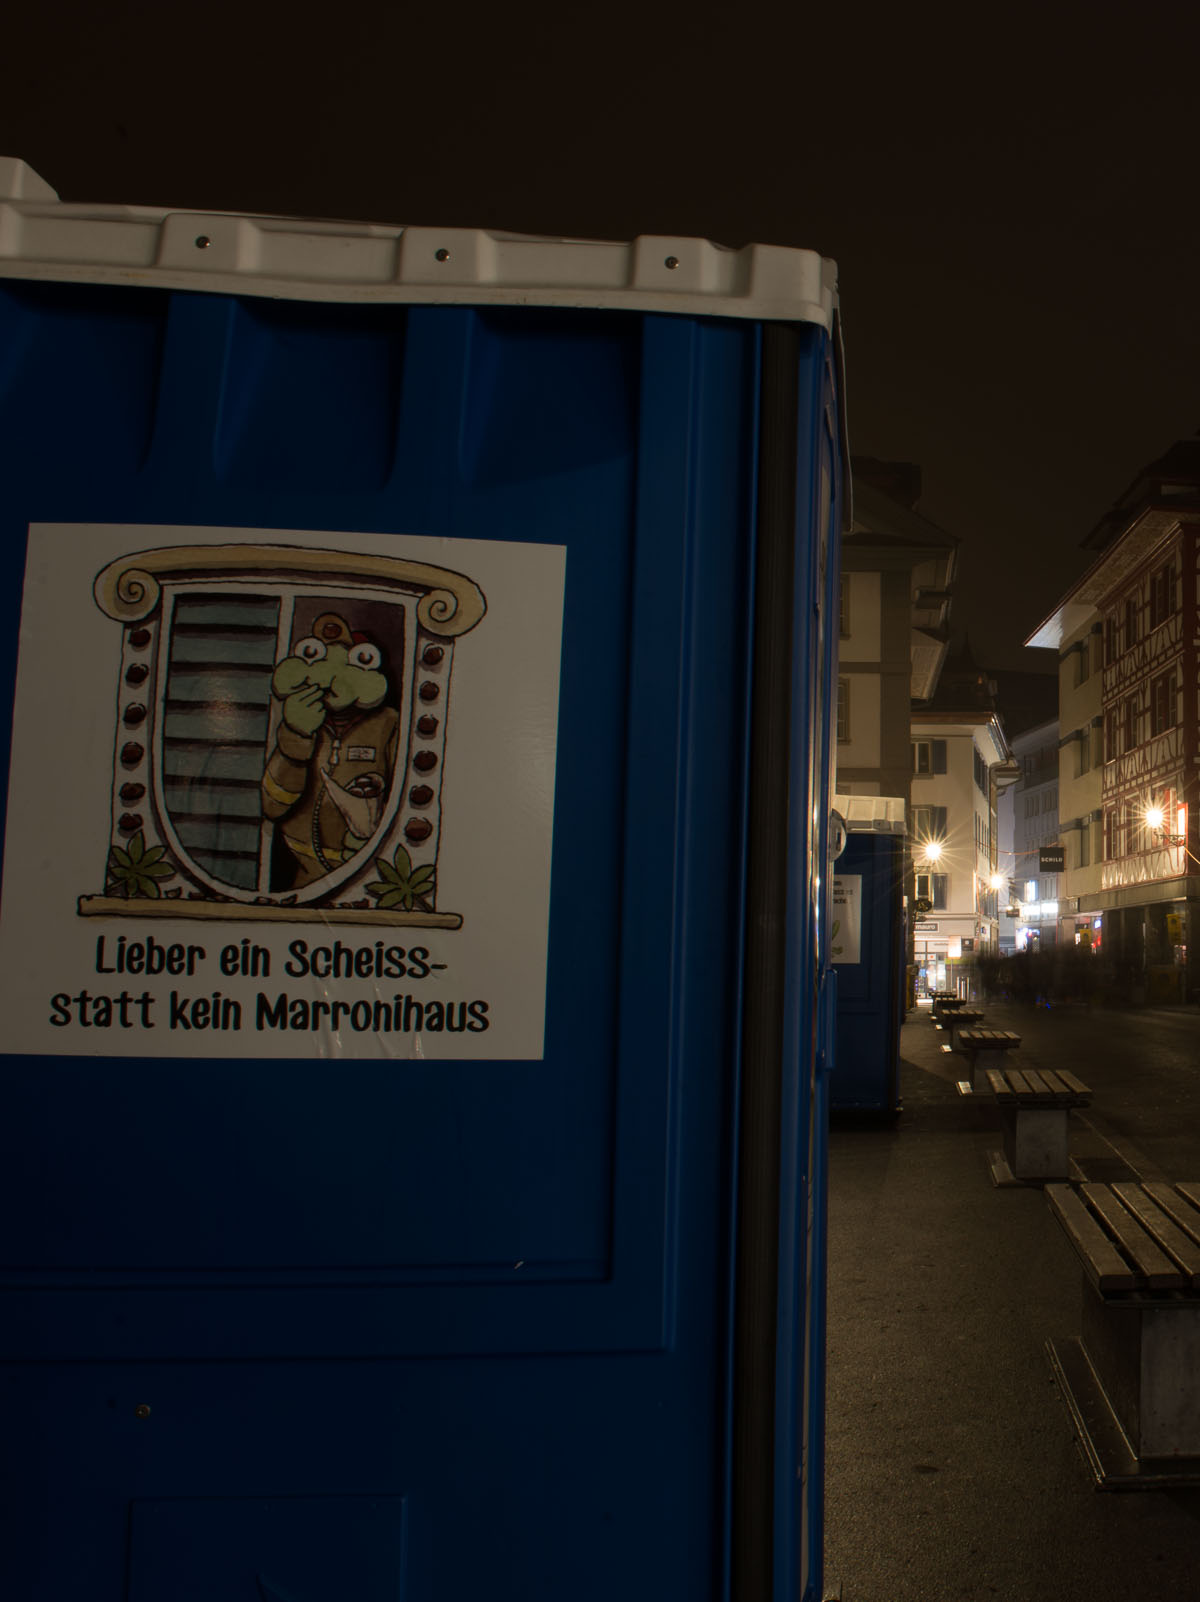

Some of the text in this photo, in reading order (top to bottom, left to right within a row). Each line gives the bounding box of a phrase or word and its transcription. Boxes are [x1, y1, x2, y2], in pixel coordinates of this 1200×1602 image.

[96, 936, 448, 979] Lieber ein Scheiss-
[49, 990, 489, 1032] statt kein Marronihaus
